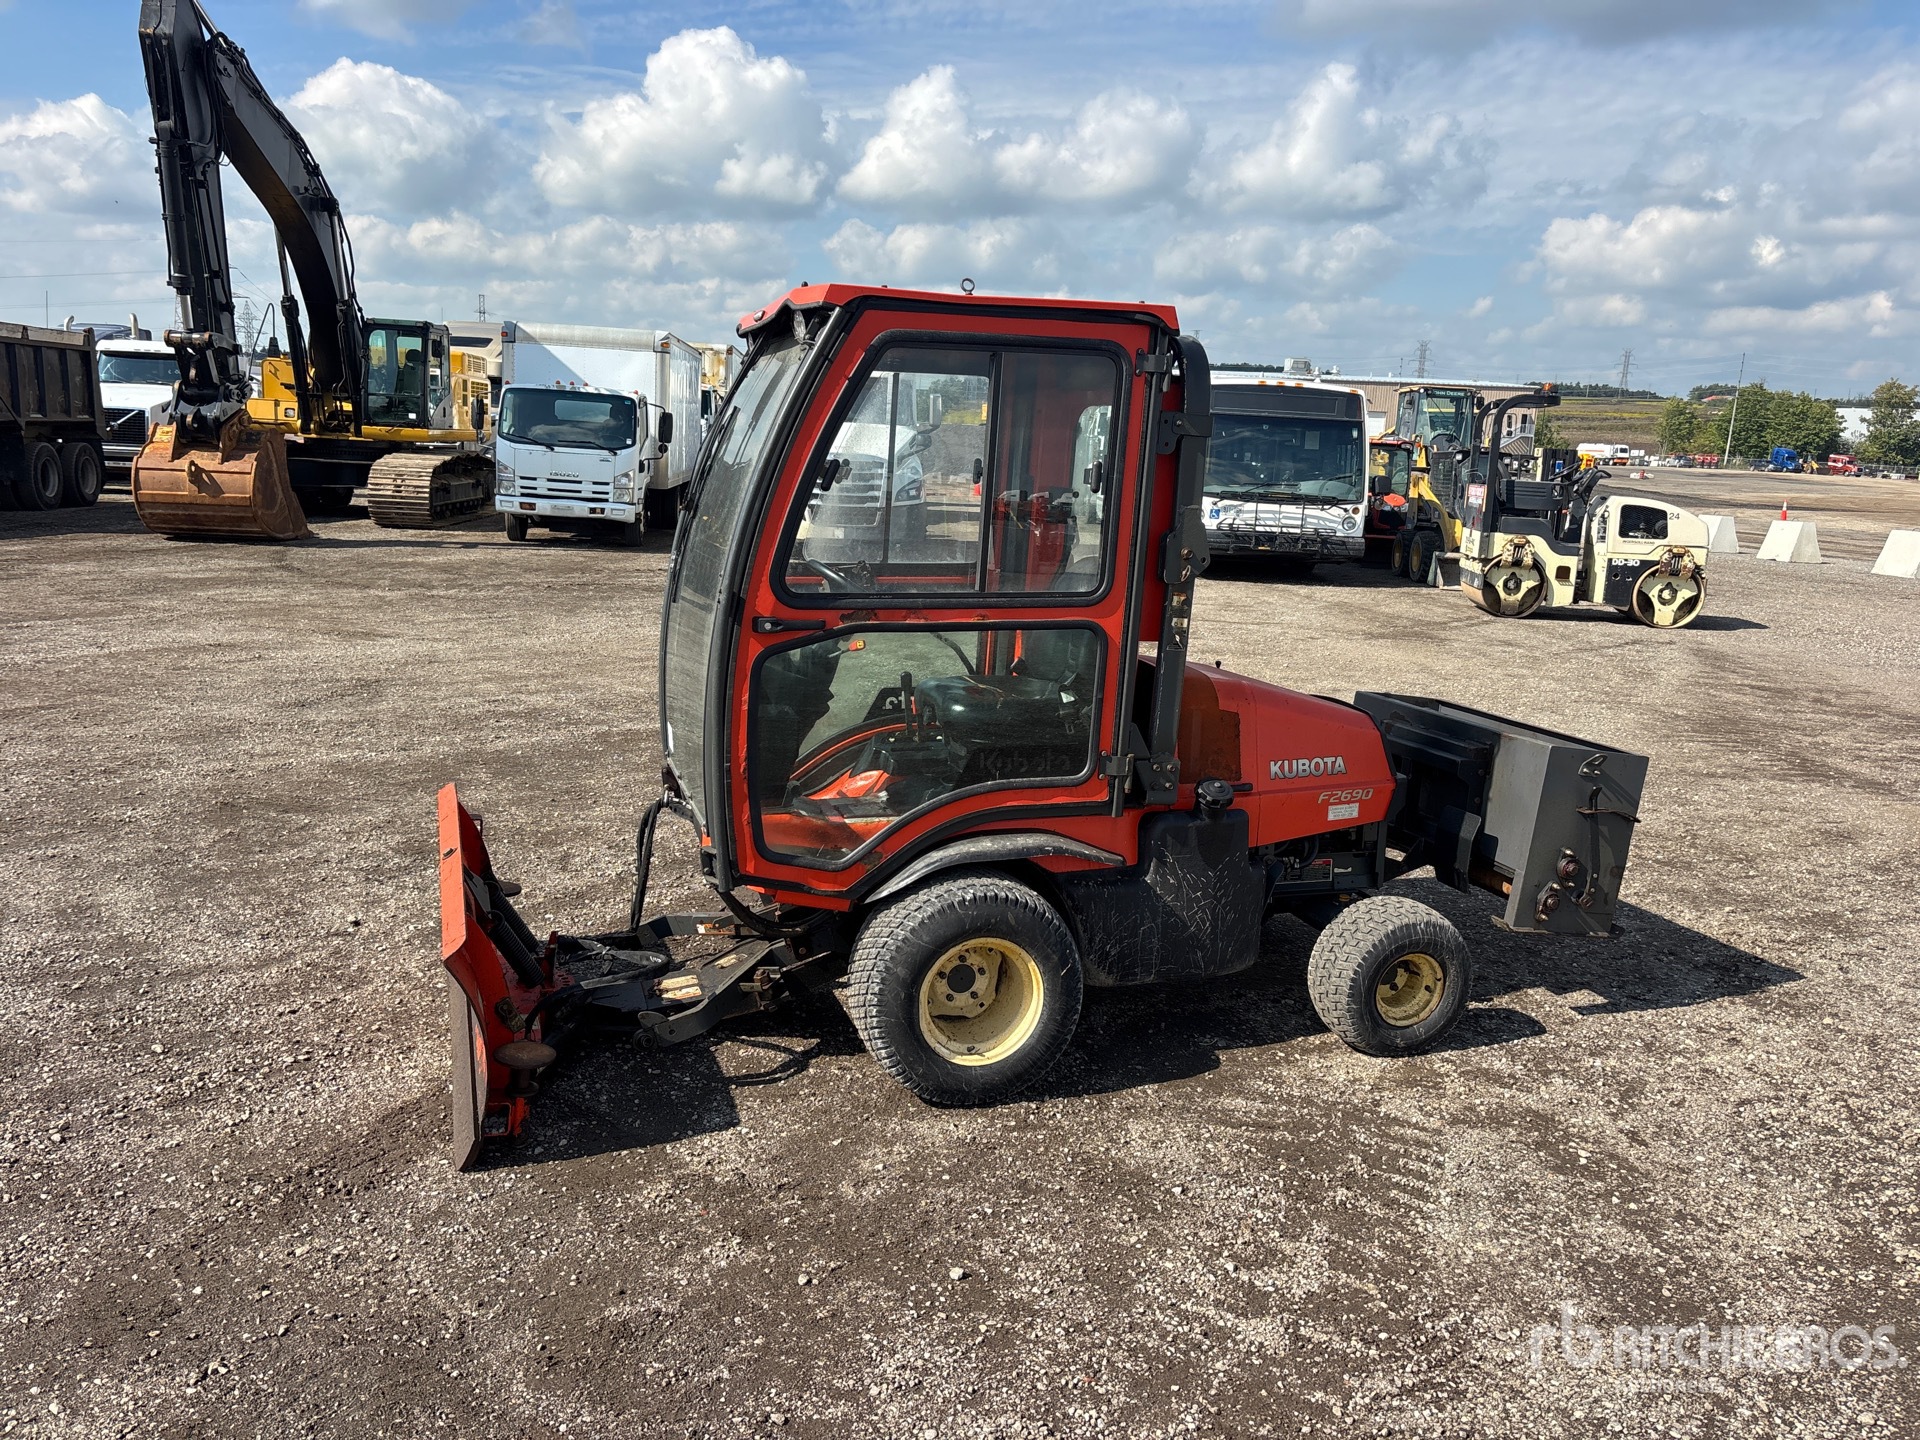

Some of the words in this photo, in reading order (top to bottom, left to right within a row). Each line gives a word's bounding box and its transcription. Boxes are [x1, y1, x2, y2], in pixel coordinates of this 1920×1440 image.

[549, 470, 580, 479] ISUZU
[1668, 512, 1681, 520] 24
[1611, 558, 1641, 567] DD-30
[1269, 755, 1347, 780] KUBOTA
[1317, 788, 1374, 804] F2690
